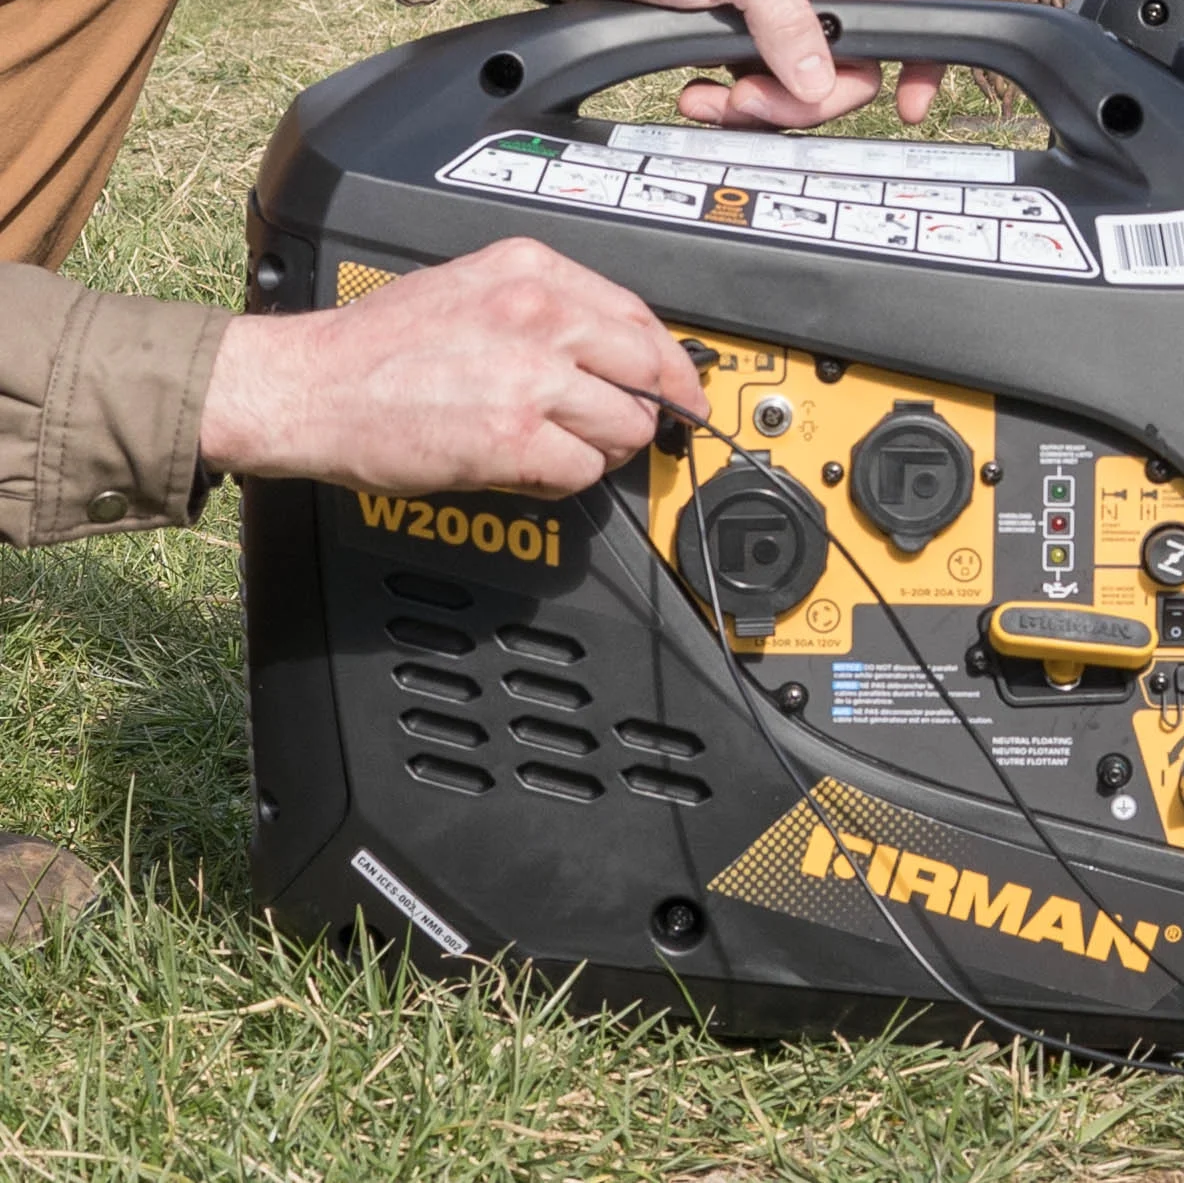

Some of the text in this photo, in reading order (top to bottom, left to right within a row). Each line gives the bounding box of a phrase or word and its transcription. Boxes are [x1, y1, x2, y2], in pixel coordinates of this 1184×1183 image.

[356, 492, 561, 567] W2000i
[934, 589, 954, 597] 20A
[957, 589, 982, 597] 120V
[817, 640, 842, 648] 120V
[992, 737, 1073, 745] NEUTRAL FLOATING
[992, 747, 1070, 756] NEUTRO FLOTANTE
[995, 758, 1069, 766] EUTRE FLOTTANT
[357, 857, 378, 876] CAN
[420, 915, 462, 951] NMB-002
